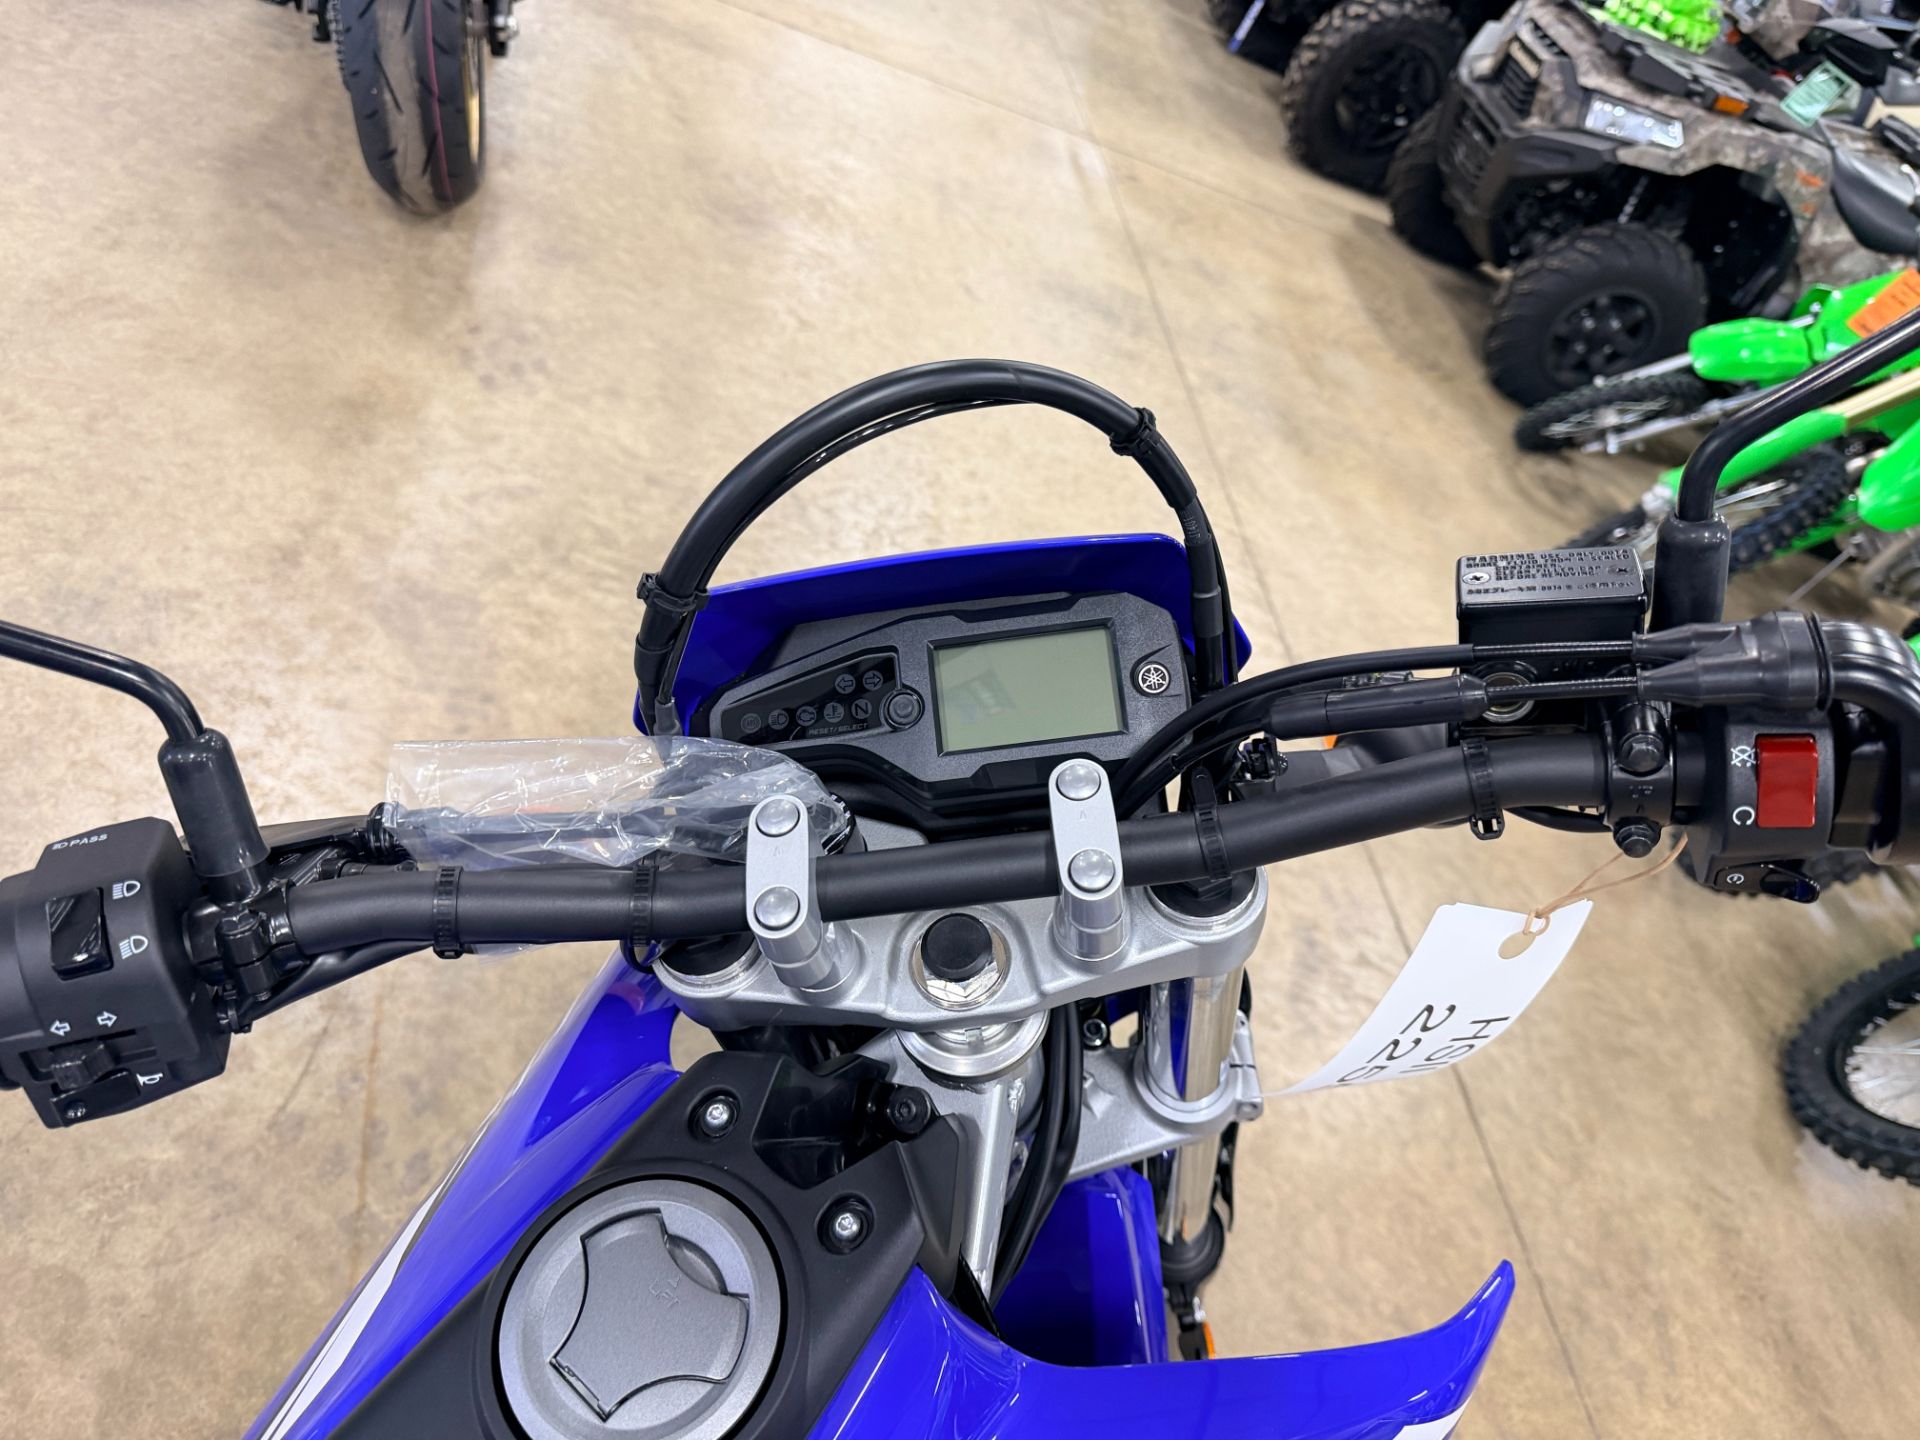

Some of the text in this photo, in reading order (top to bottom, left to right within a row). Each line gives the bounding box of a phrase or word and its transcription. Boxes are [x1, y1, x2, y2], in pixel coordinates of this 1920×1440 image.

[1466, 553, 1535, 562] WARNING
[808, 722, 869, 736] RESET/SELECT
[69, 833, 108, 847] PASS
